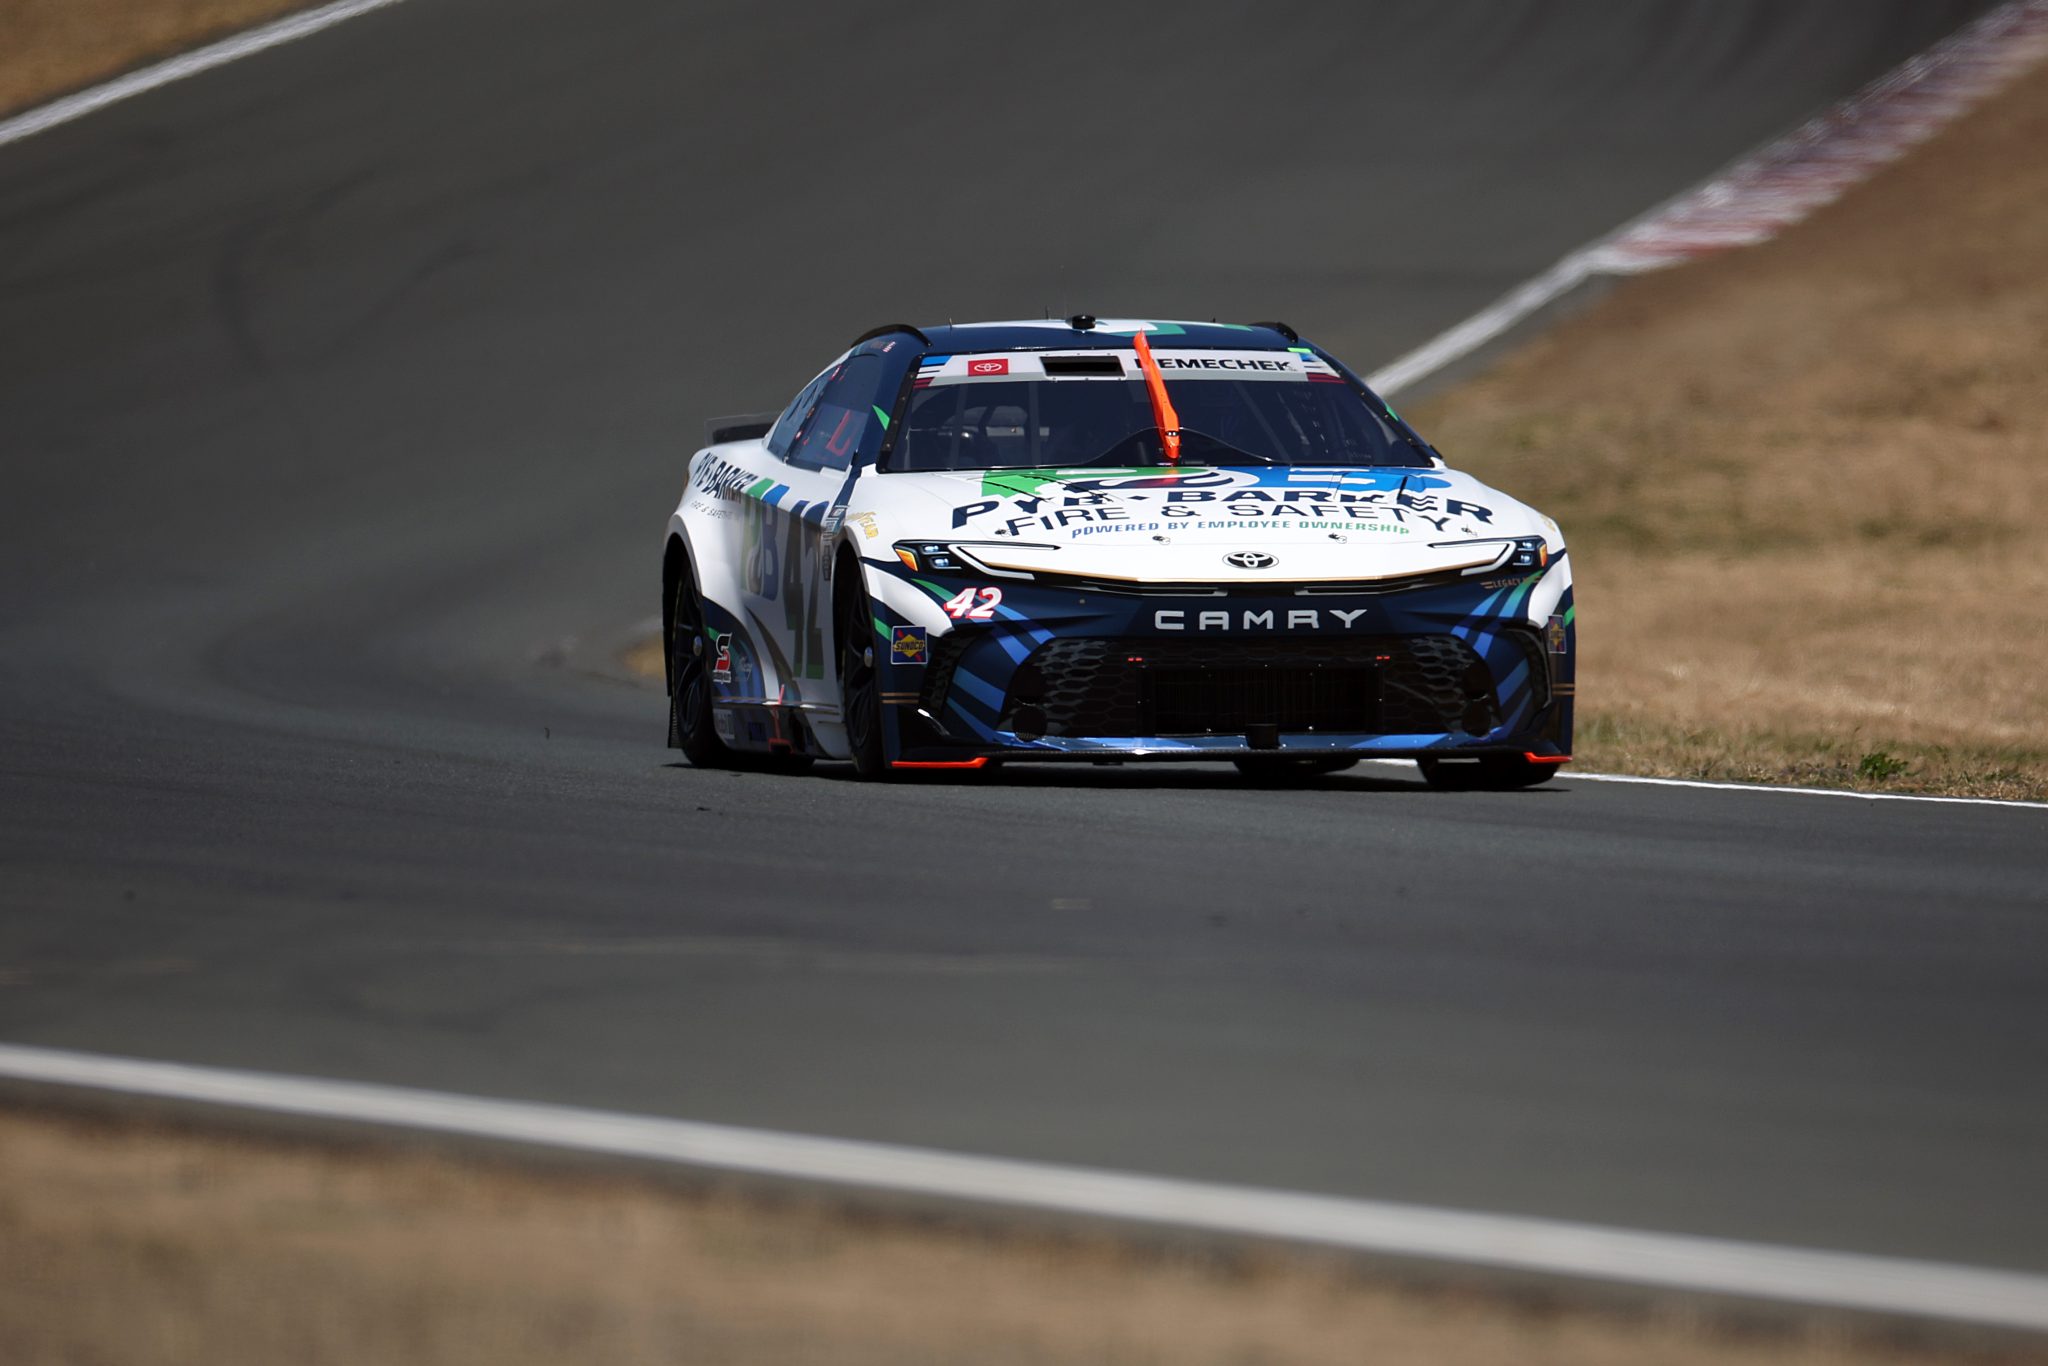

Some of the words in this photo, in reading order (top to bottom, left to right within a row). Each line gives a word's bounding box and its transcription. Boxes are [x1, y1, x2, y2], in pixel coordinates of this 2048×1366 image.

[1006, 507, 1130, 536] FIRE
[1160, 505, 1201, 517] &
[1227, 504, 1452, 532] SAFETY
[1071, 522, 1160, 539] POWERED
[1168, 521, 1189, 530] BY
[1197, 520, 1291, 530] EMPLOYEE
[1298, 520, 1411, 535] OWNERSHIP
[943, 587, 1003, 619] 42
[1154, 608, 1368, 631] CAMRY
[893, 640, 926, 652] SUNOCO
